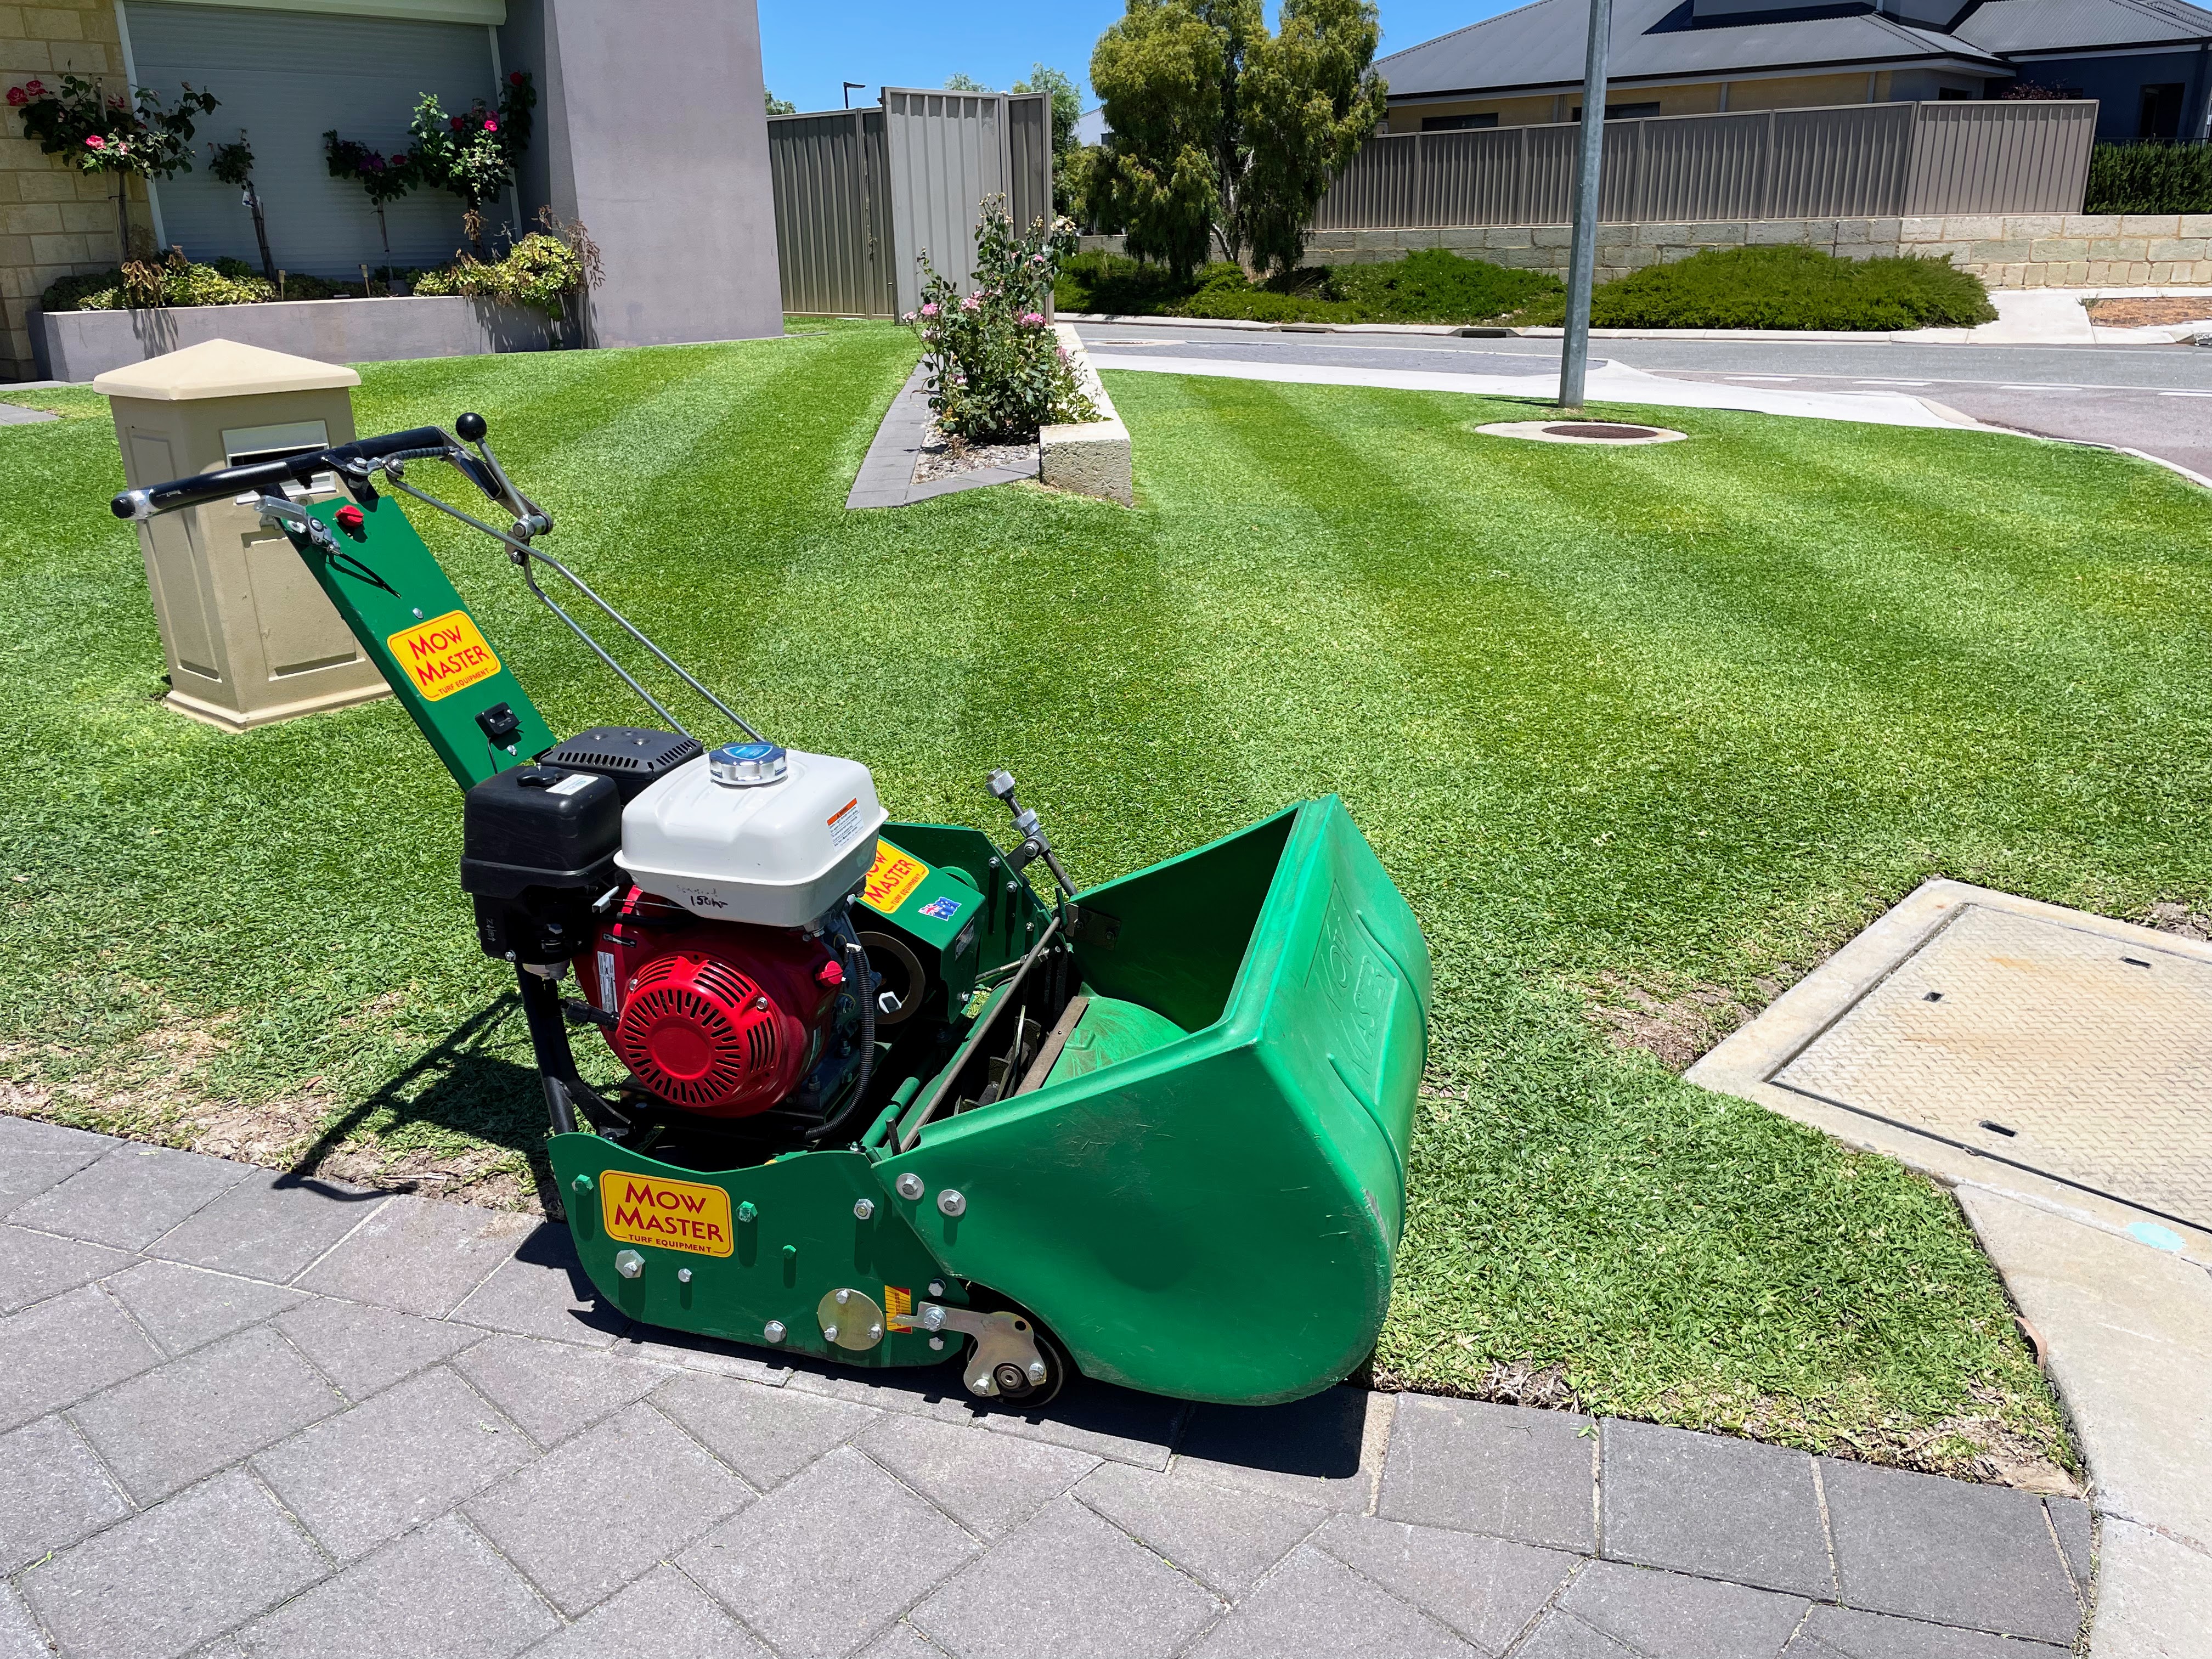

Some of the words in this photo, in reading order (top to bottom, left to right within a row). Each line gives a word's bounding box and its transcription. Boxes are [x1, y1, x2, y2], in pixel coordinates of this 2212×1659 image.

[408, 625, 462, 661] MOW
[414, 646, 490, 686] MASTER
[438, 684, 455, 695] TURF
[455, 668, 490, 688] EQUIPMENT
[865, 859, 916, 904] MASTER
[890, 894, 903, 905] TURF
[900, 873, 922, 897] EQUIPMENT
[625, 1181, 707, 1214] MOW
[614, 1204, 724, 1243] MASTER
[629, 1234, 653, 1244] TURF
[656, 1238, 712, 1253] EQUIPMENT
